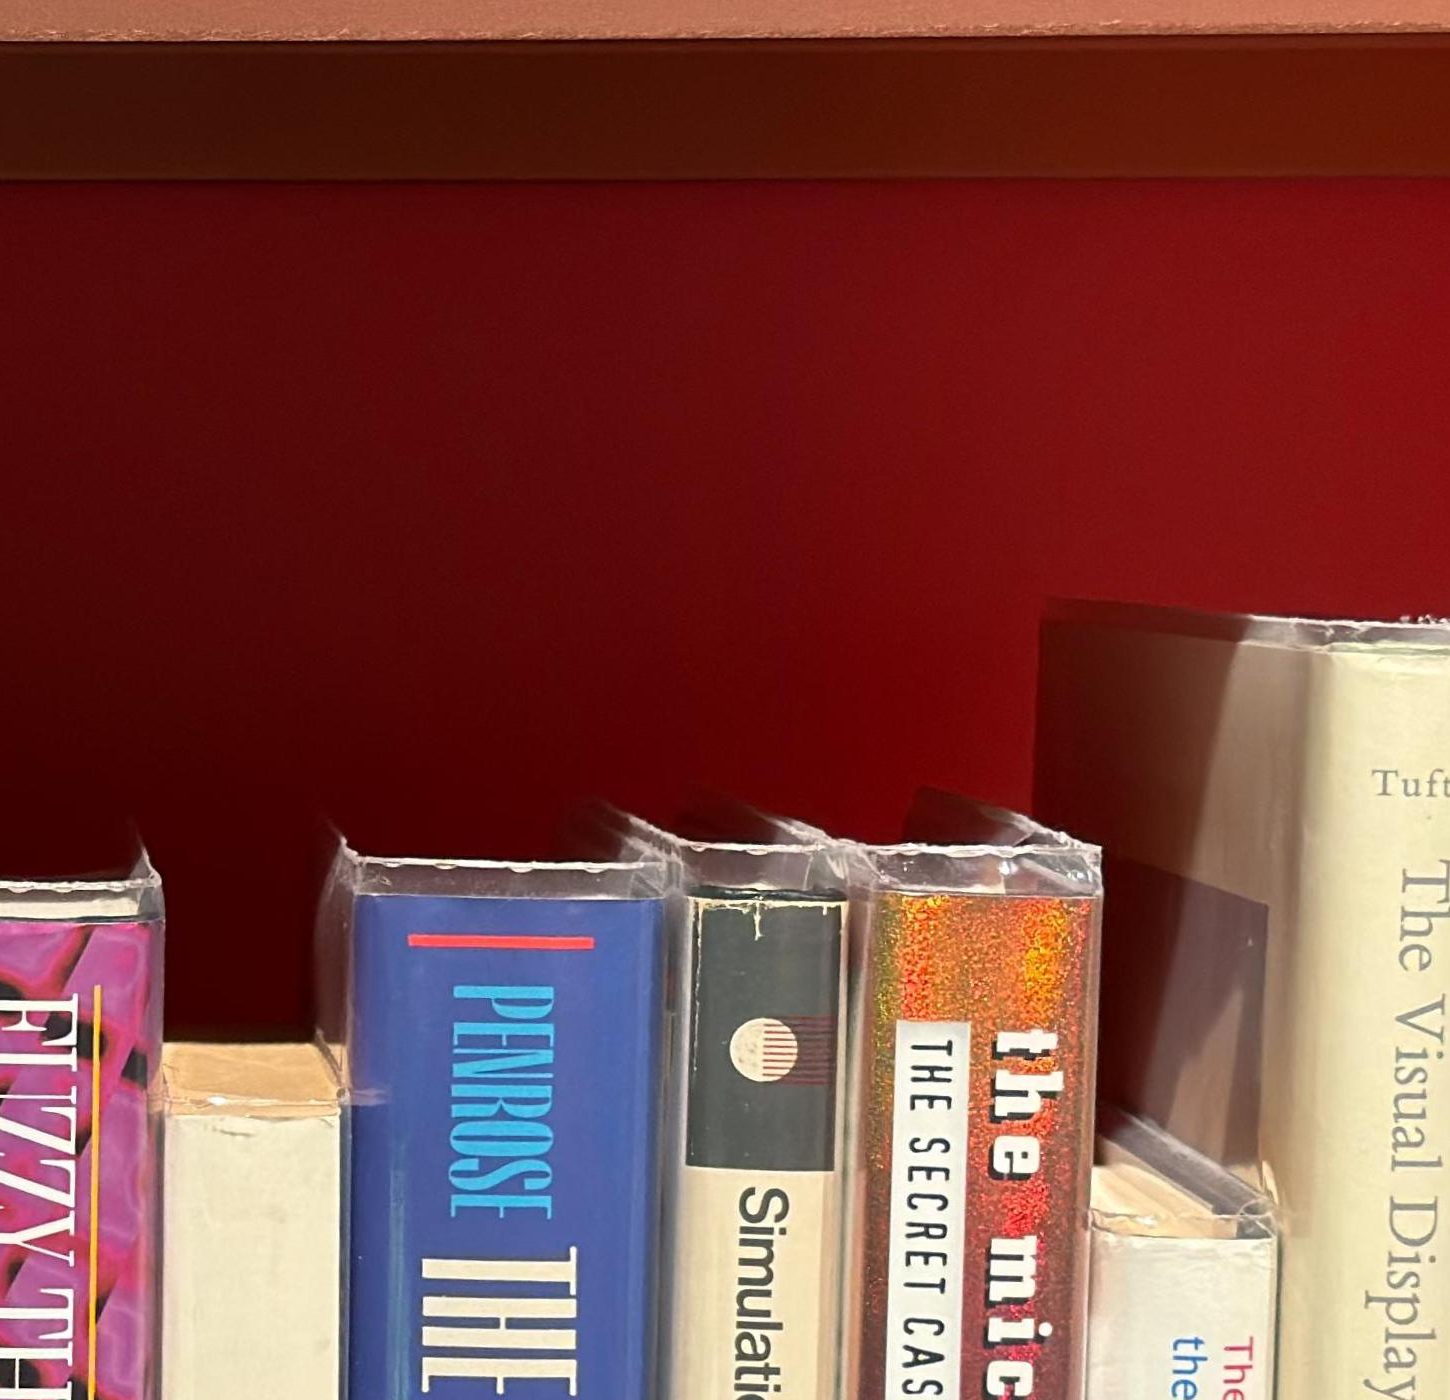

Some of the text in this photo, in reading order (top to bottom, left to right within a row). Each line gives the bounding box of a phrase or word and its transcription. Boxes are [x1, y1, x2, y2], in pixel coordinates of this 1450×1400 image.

[449, 986, 555, 1219] PENROSE
[989, 1030, 1063, 1181] the
[1391, 994, 1445, 1171] Visual
[422, 1246, 577, 1396] THE
[1172, 1337, 1208, 1400] the
